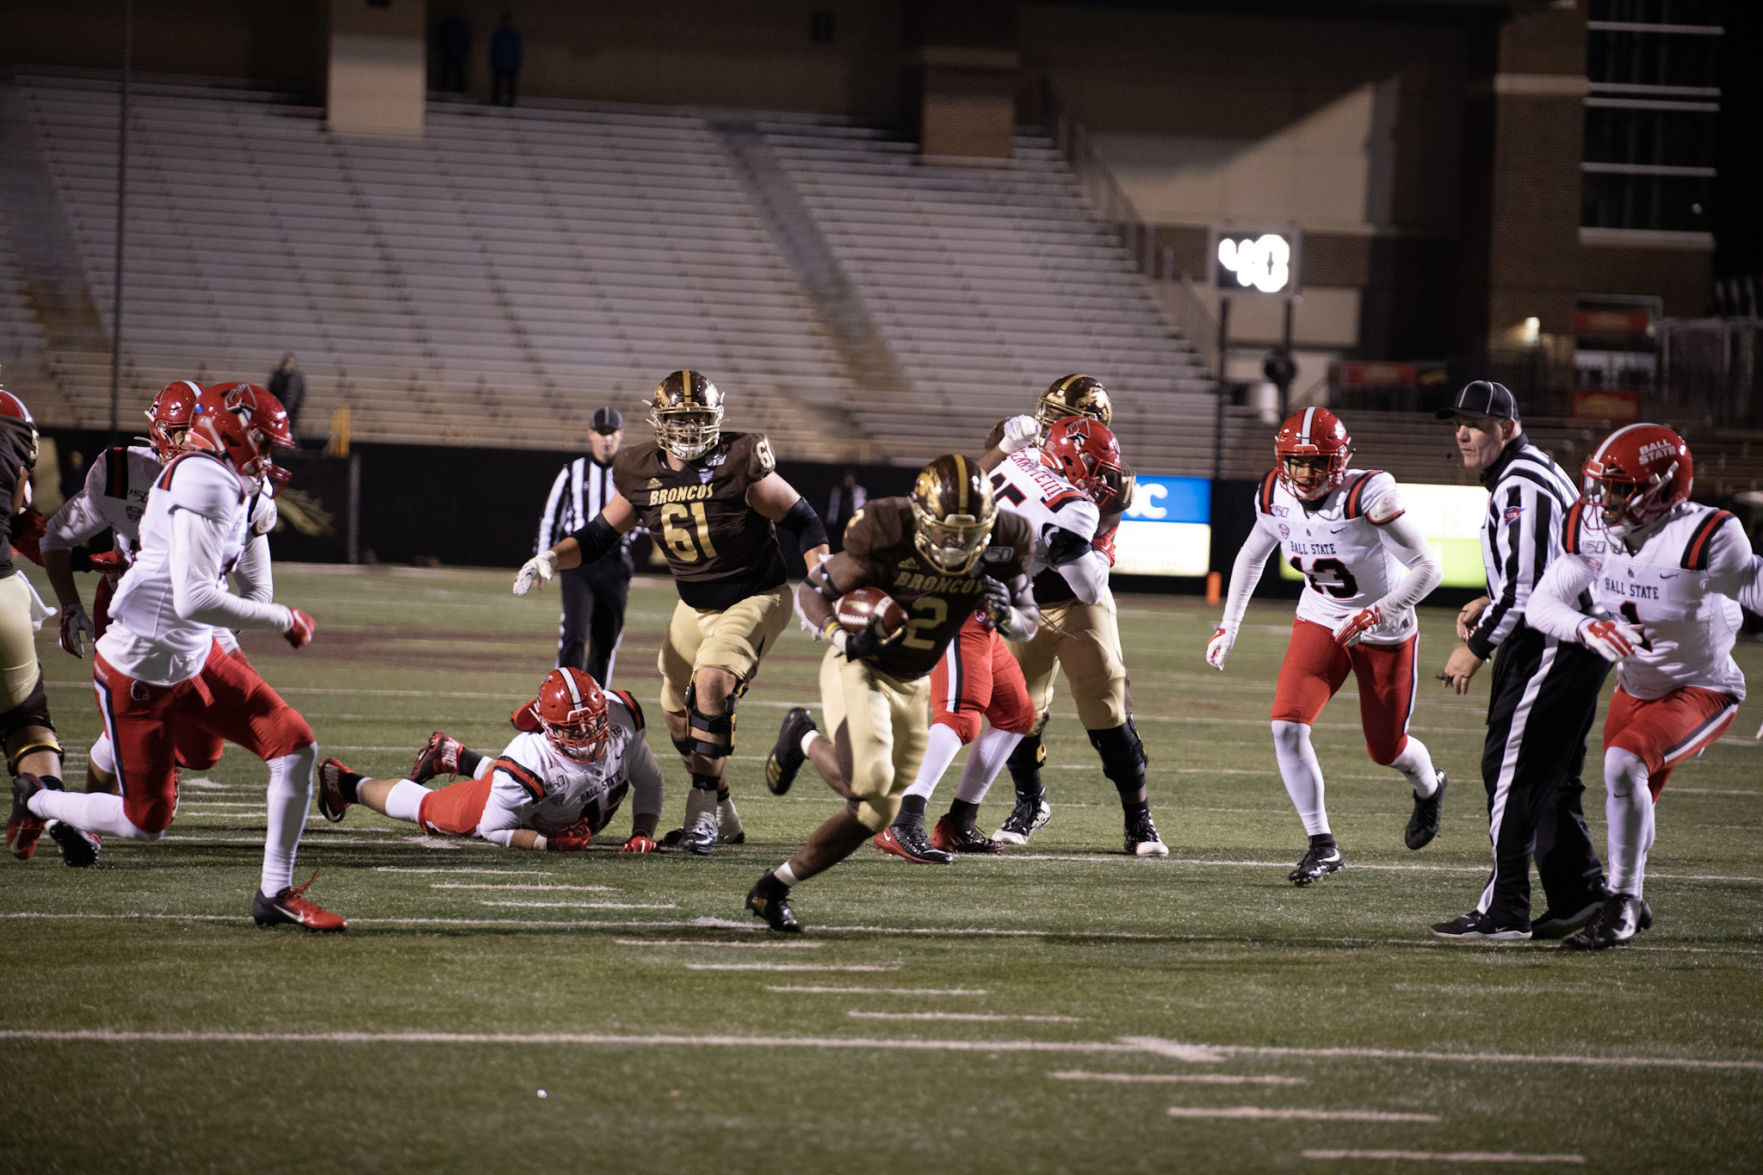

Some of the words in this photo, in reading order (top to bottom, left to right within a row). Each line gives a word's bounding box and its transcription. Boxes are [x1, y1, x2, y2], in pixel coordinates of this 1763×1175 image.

[1218, 234, 1289, 293] 40
[1638, 445, 1677, 465] STATE
[1639, 438, 1673, 456] BALL
[649, 483, 714, 506] BRONCOS
[661, 501, 717, 562] 61
[1290, 541, 1309, 555] BALL
[1311, 543, 1337, 555] STATE
[894, 571, 984, 594] BRONCOS
[1290, 556, 1359, 599] 13
[1605, 577, 1626, 596] BALL
[1629, 584, 1659, 600] STATE
[902, 596, 949, 650] 2
[1620, 600, 1654, 653] 1
